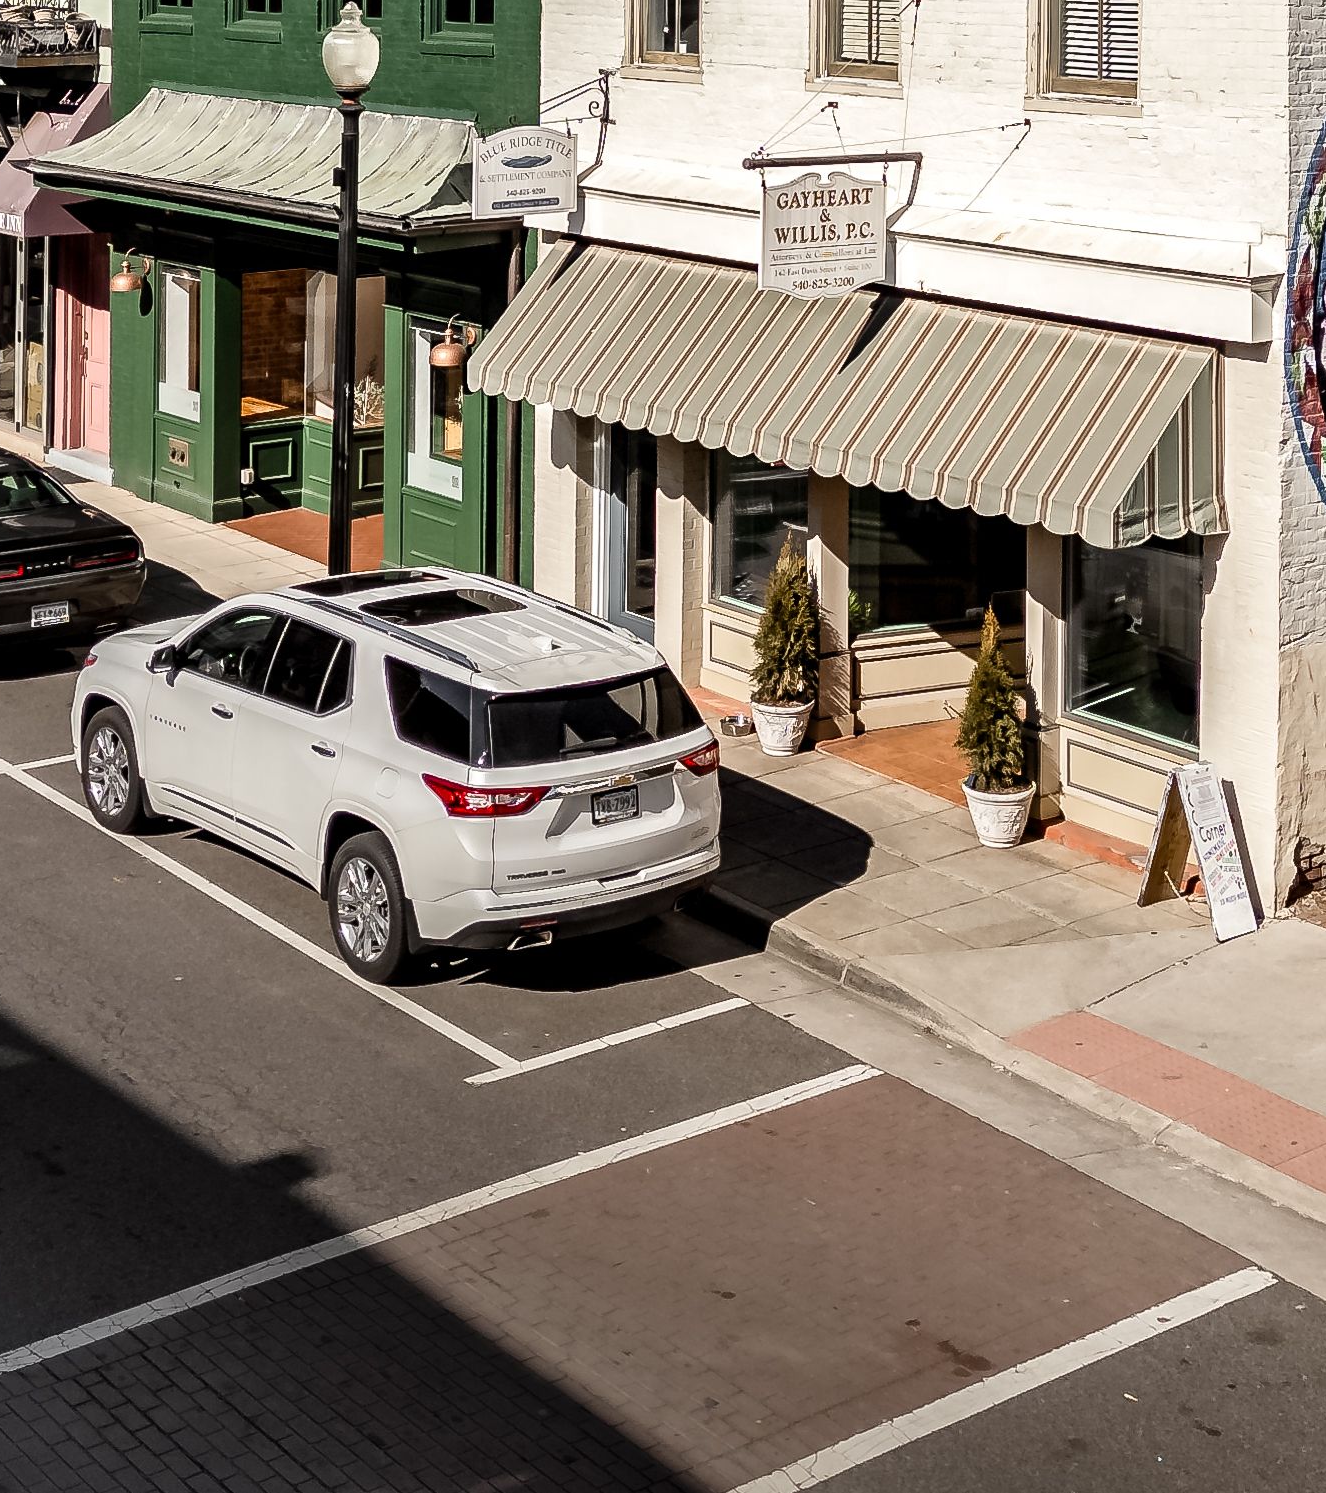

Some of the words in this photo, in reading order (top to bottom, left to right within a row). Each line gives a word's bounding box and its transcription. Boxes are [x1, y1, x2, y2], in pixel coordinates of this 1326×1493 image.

[480, 141, 507, 164] BLUE
[510, 137, 543, 148] RIDGE
[545, 138, 574, 159] TITLE
[479, 175, 486, 183] &
[487, 172, 535, 183] SETTLEMENT
[536, 169, 572, 179] COMPANY
[776, 188, 874, 210] GAYHEART
[6, 214, 22, 233] INN
[819, 208, 831, 223] &
[774, 223, 841, 244] WILLIS,
[845, 221, 875, 240] P.C.
[792, 276, 855, 291] 540-825-3200
[1199, 823, 1227, 843] Corner
